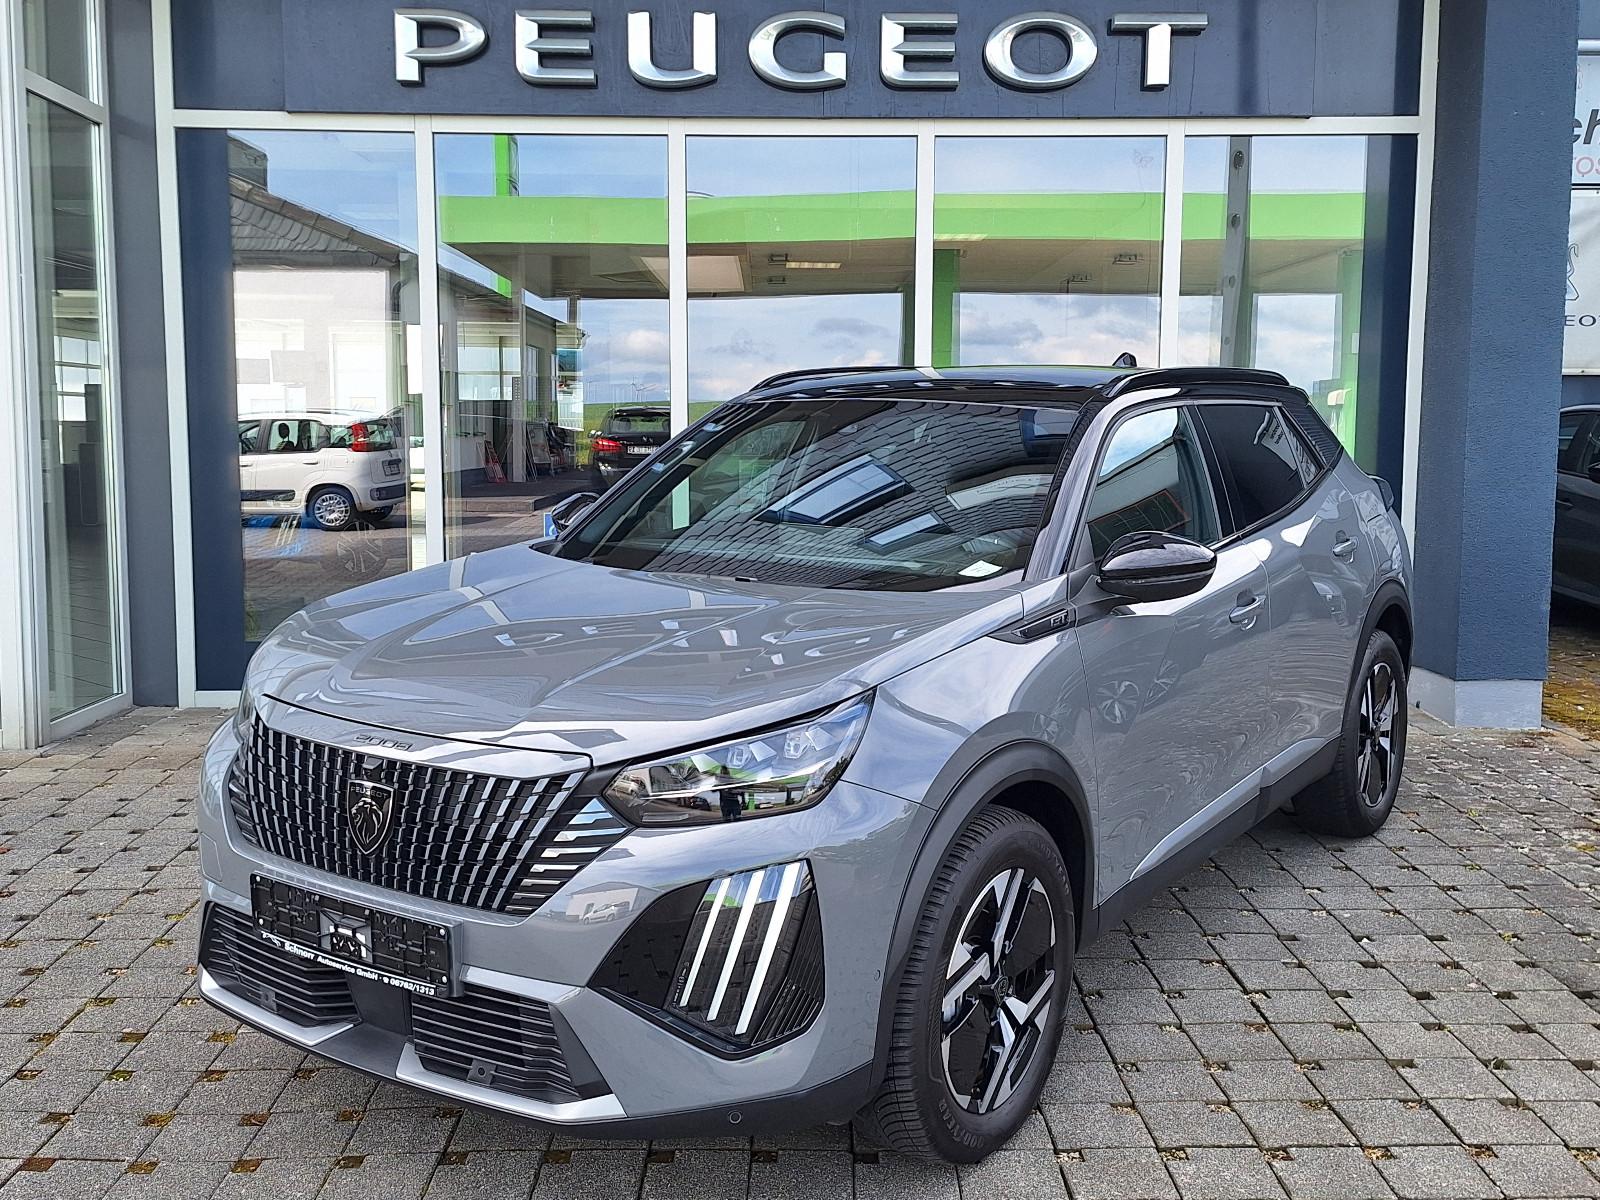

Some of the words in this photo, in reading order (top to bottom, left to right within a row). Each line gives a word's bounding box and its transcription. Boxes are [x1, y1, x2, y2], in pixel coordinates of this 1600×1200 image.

[393, 9, 1208, 90] PEUGEOT
[355, 735, 413, 751] 2008
[350, 785, 389, 799] PEUGEOT
[284, 942, 315, 960] Schnorr
[317, 955, 355, 974] Autoservice
[356, 968, 378, 981] GmbH
